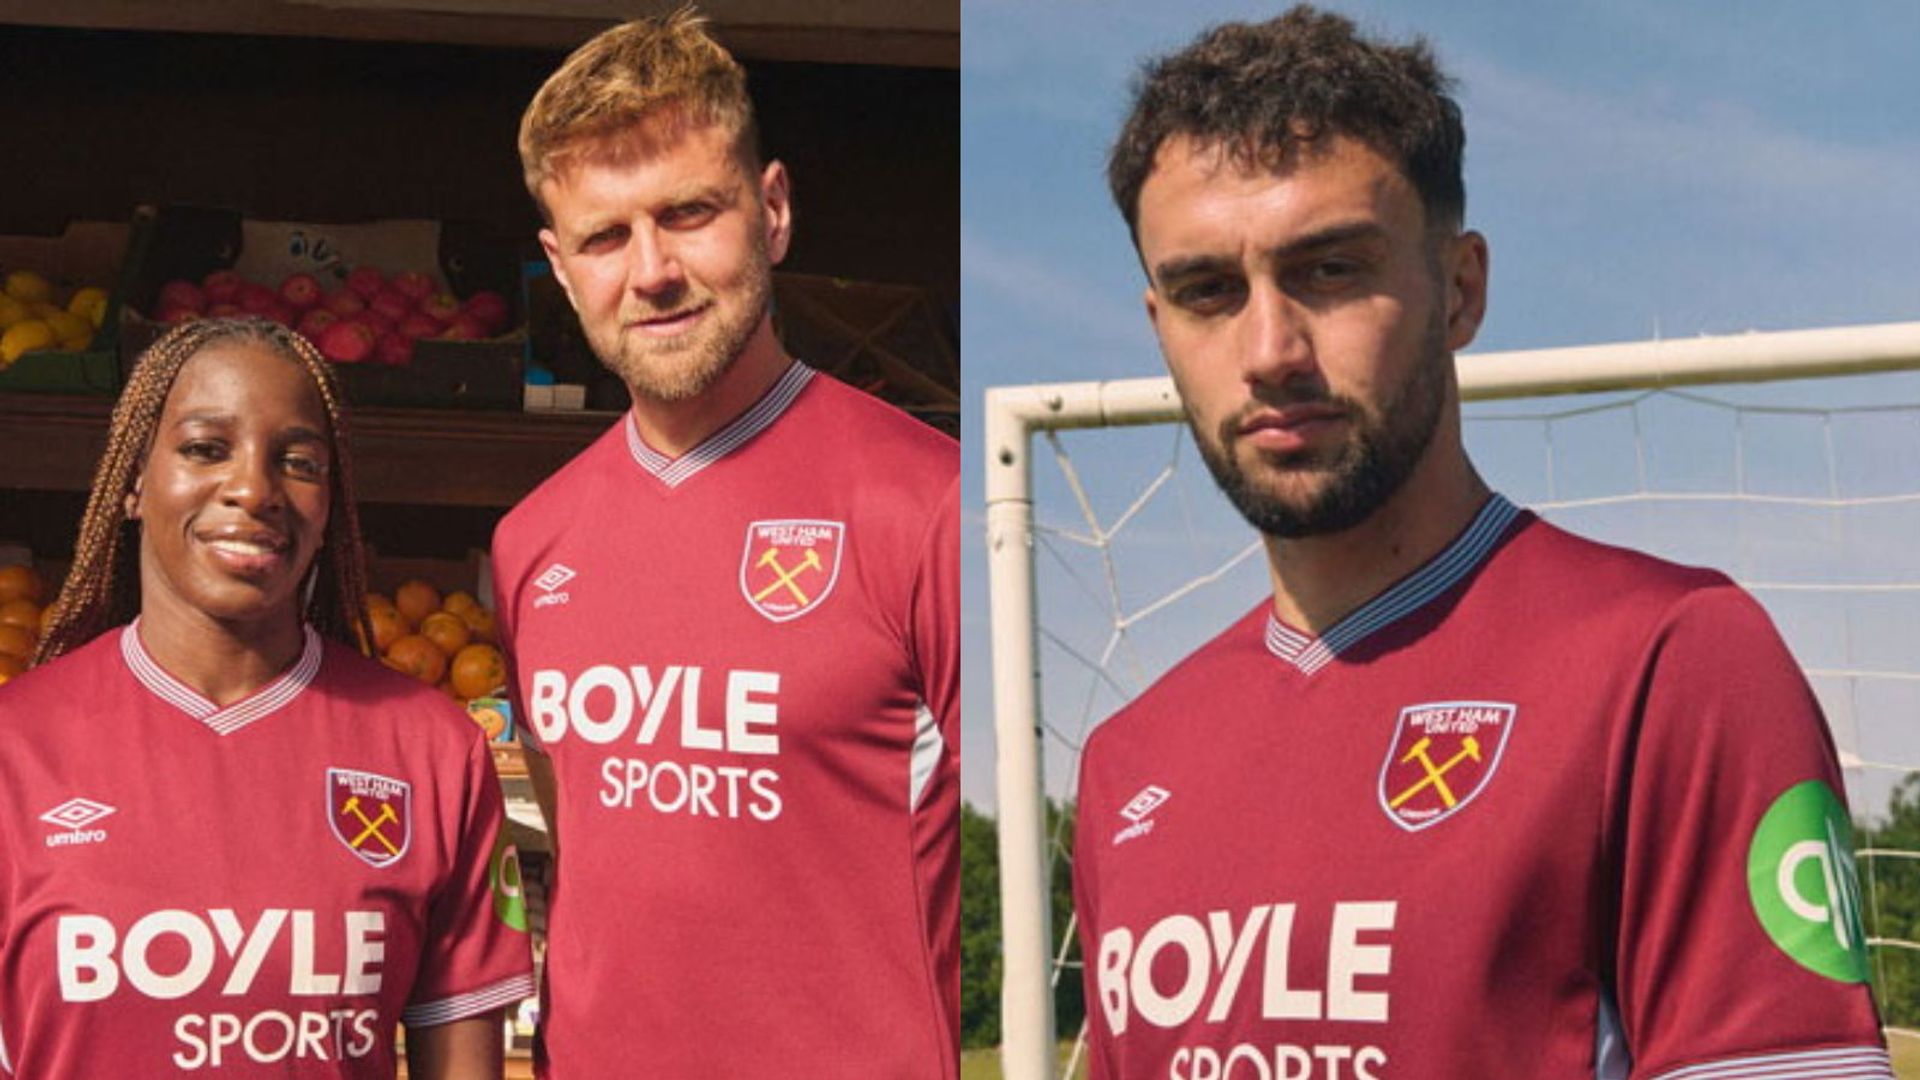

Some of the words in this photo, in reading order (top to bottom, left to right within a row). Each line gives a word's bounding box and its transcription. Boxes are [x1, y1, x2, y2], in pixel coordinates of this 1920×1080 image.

[799, 527, 832, 541] HAM
[531, 665, 780, 755] BOYLE
[1411, 707, 1455, 726] WEST
[1457, 708, 1501, 725] HAM
[1425, 719, 1479, 734] UNITED
[600, 756, 782, 821] SPORTS
[46, 828, 107, 847] umbro
[57, 909, 385, 1002] BOYLE
[1098, 901, 1397, 1037] BOYLE
[172, 1009, 378, 1070] SPORTS
